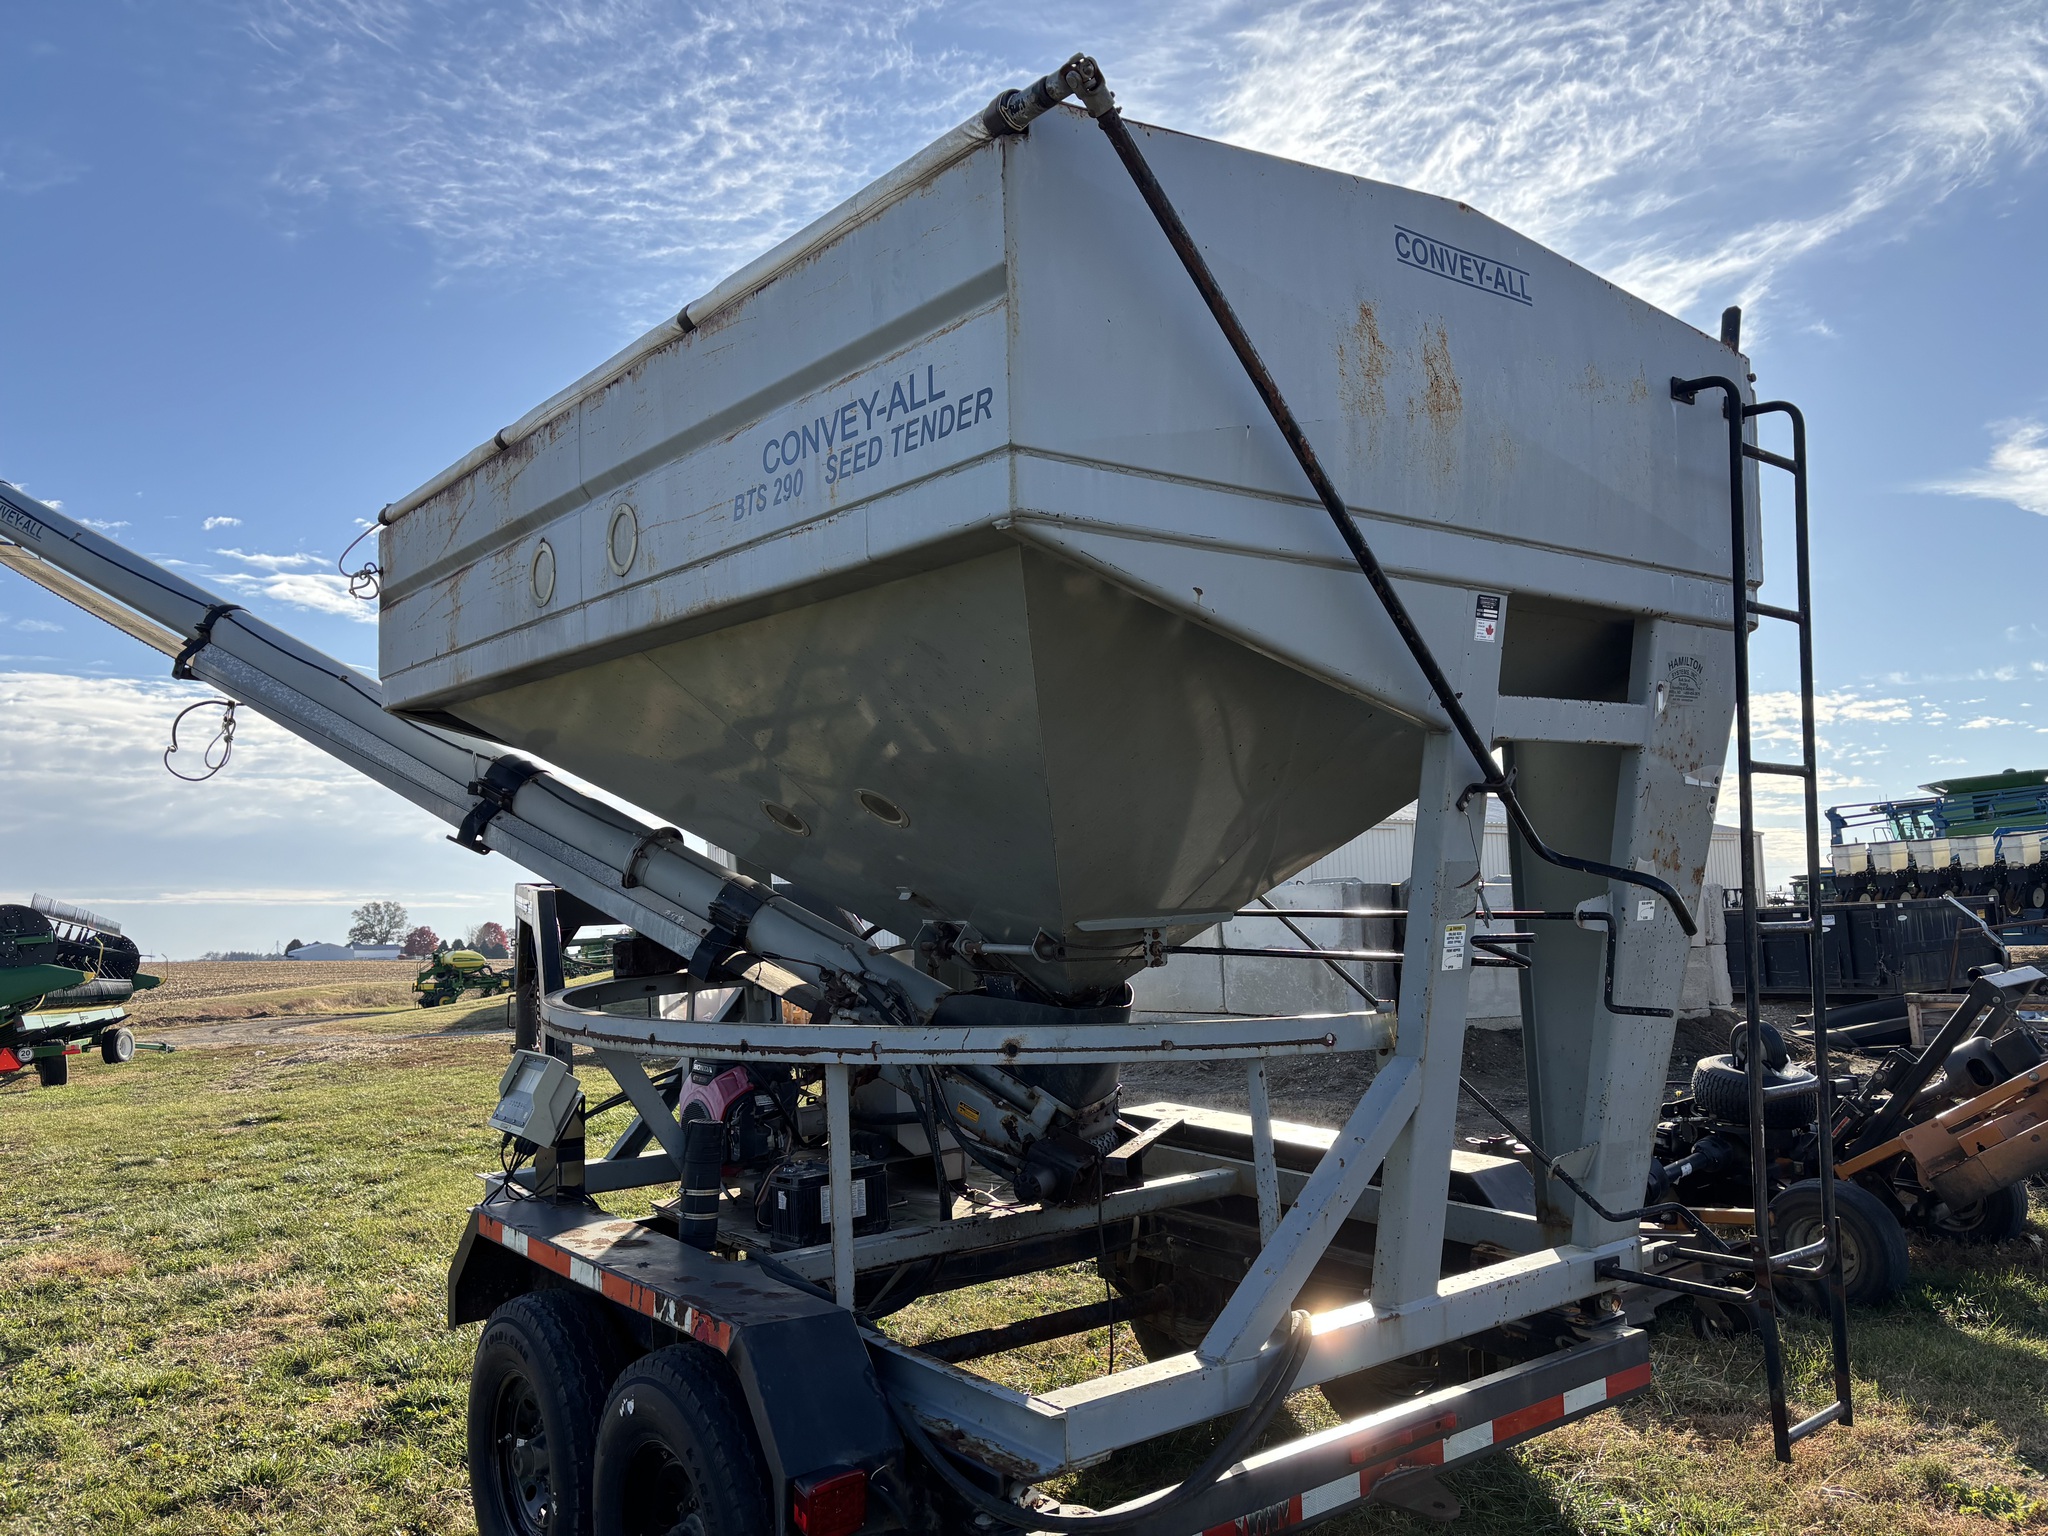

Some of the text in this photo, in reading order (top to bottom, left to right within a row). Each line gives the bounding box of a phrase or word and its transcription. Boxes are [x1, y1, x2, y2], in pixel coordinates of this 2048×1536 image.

[1395, 231, 1532, 301] CONVEY-ALL
[733, 387, 993, 522] BTS 290 SEED TENDER
[762, 364, 946, 474] CONVEY-ALL
[1668, 656, 1703, 674] HAMILTON
